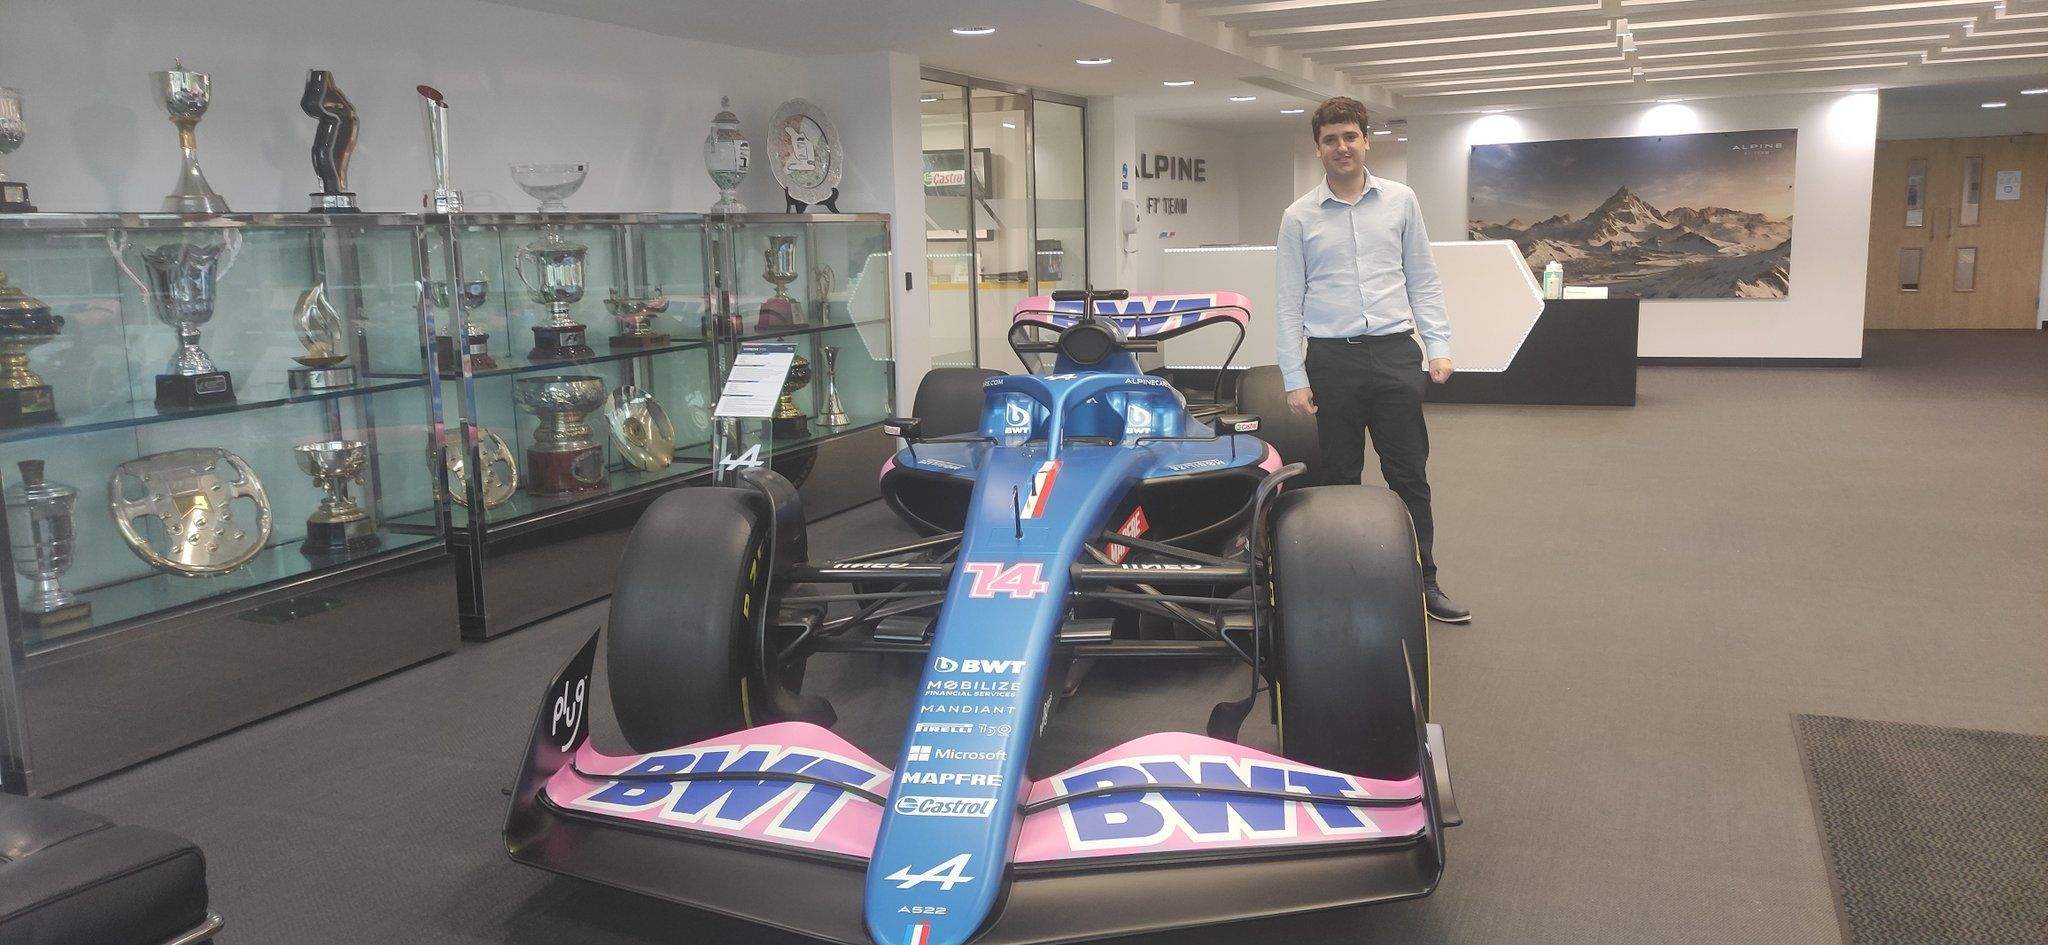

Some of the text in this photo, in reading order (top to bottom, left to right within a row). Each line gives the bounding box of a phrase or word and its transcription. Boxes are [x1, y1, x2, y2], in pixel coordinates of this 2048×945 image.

[1162, 197, 1188, 214] TEAM
[1005, 426, 1029, 434] BWT
[963, 561, 1049, 599] 14
[960, 659, 1026, 674] BWT
[552, 678, 586, 752] plug
[920, 704, 1017, 715] MANDIANT
[915, 722, 974, 734] PIRELLI
[934, 748, 1008, 761] Microsoft
[901, 771, 1004, 787] MAPFRE
[577, 748, 888, 839] BWT
[918, 798, 990, 815] Castrol
[1053, 756, 1377, 848] BWT
[897, 905, 947, 915] A522
